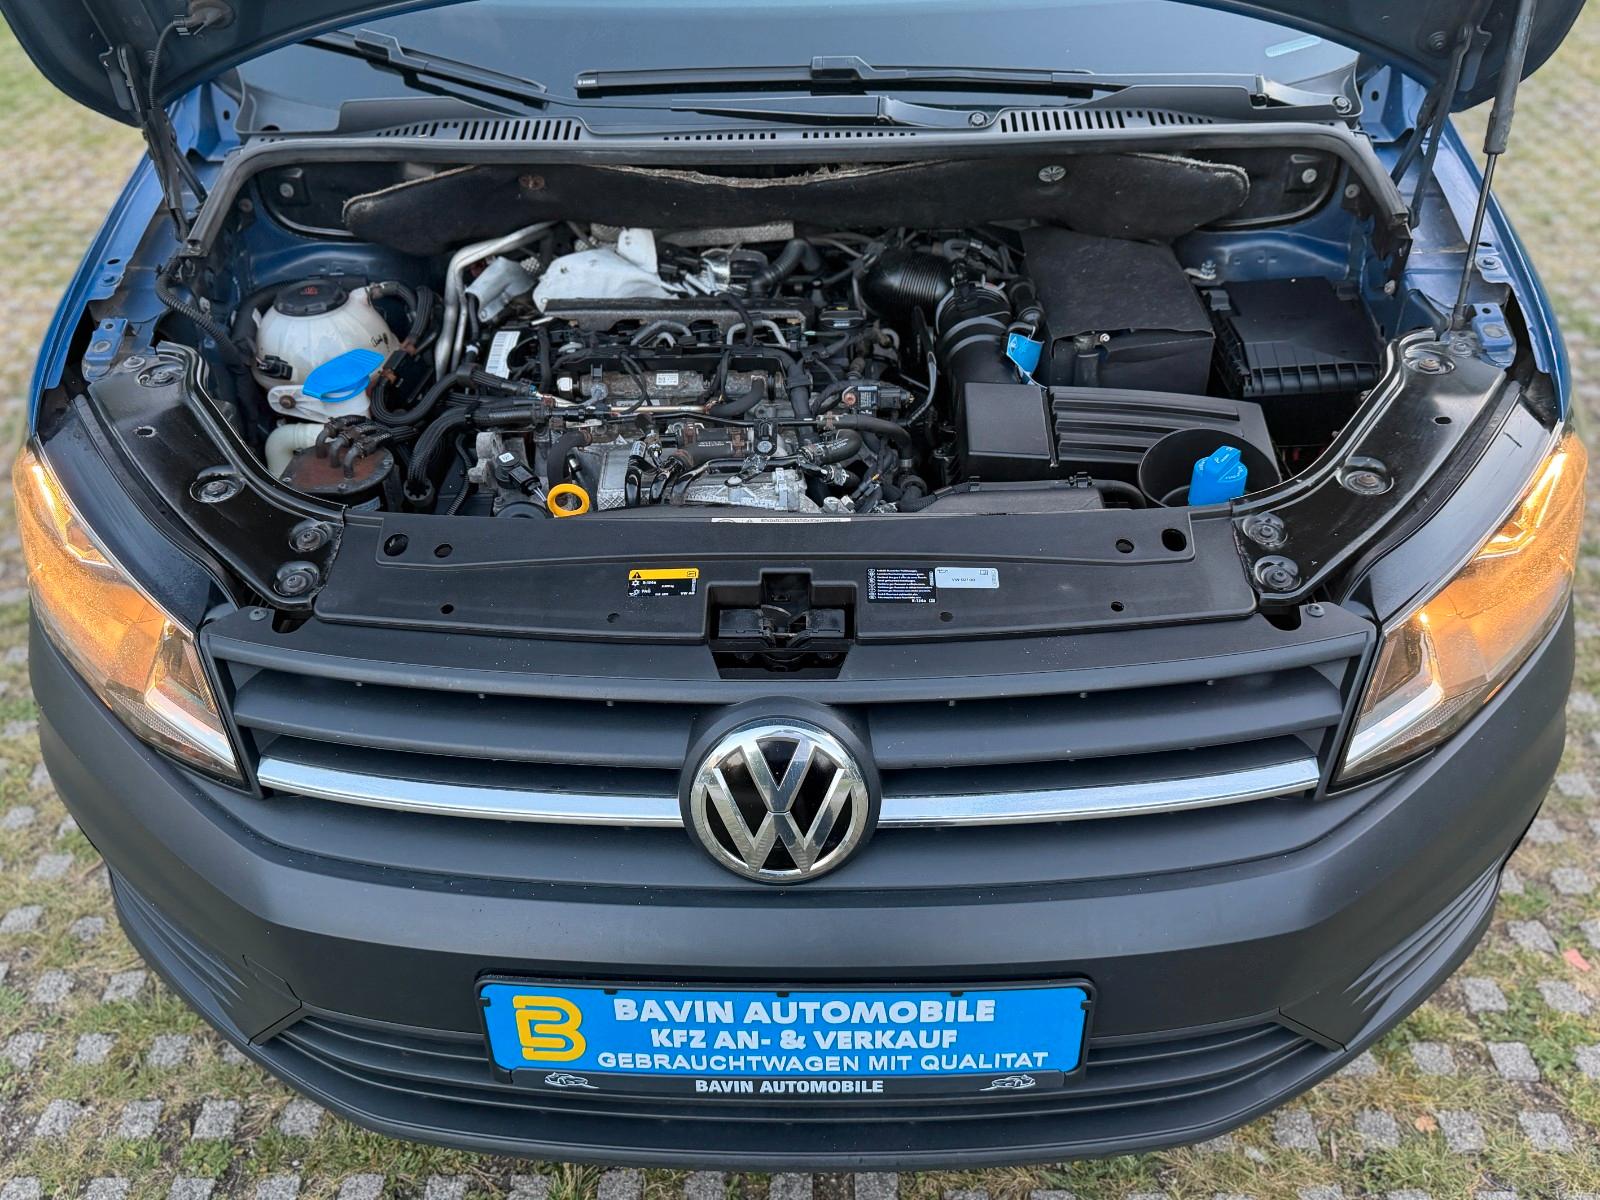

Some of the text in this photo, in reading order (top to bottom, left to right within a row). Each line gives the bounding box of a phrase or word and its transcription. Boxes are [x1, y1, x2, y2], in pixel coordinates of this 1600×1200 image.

[693, 722, 867, 880] VW
[613, 998, 996, 1024] BAVIN AUTOMOBILE
[650, 1028, 958, 1050] KFZ AN- & VERKAUF
[597, 1051, 1049, 1072] GEBRAUCHTWAGEN MIT QUALITAT
[695, 1079, 884, 1094] BAVIN AUTOMOBILE
